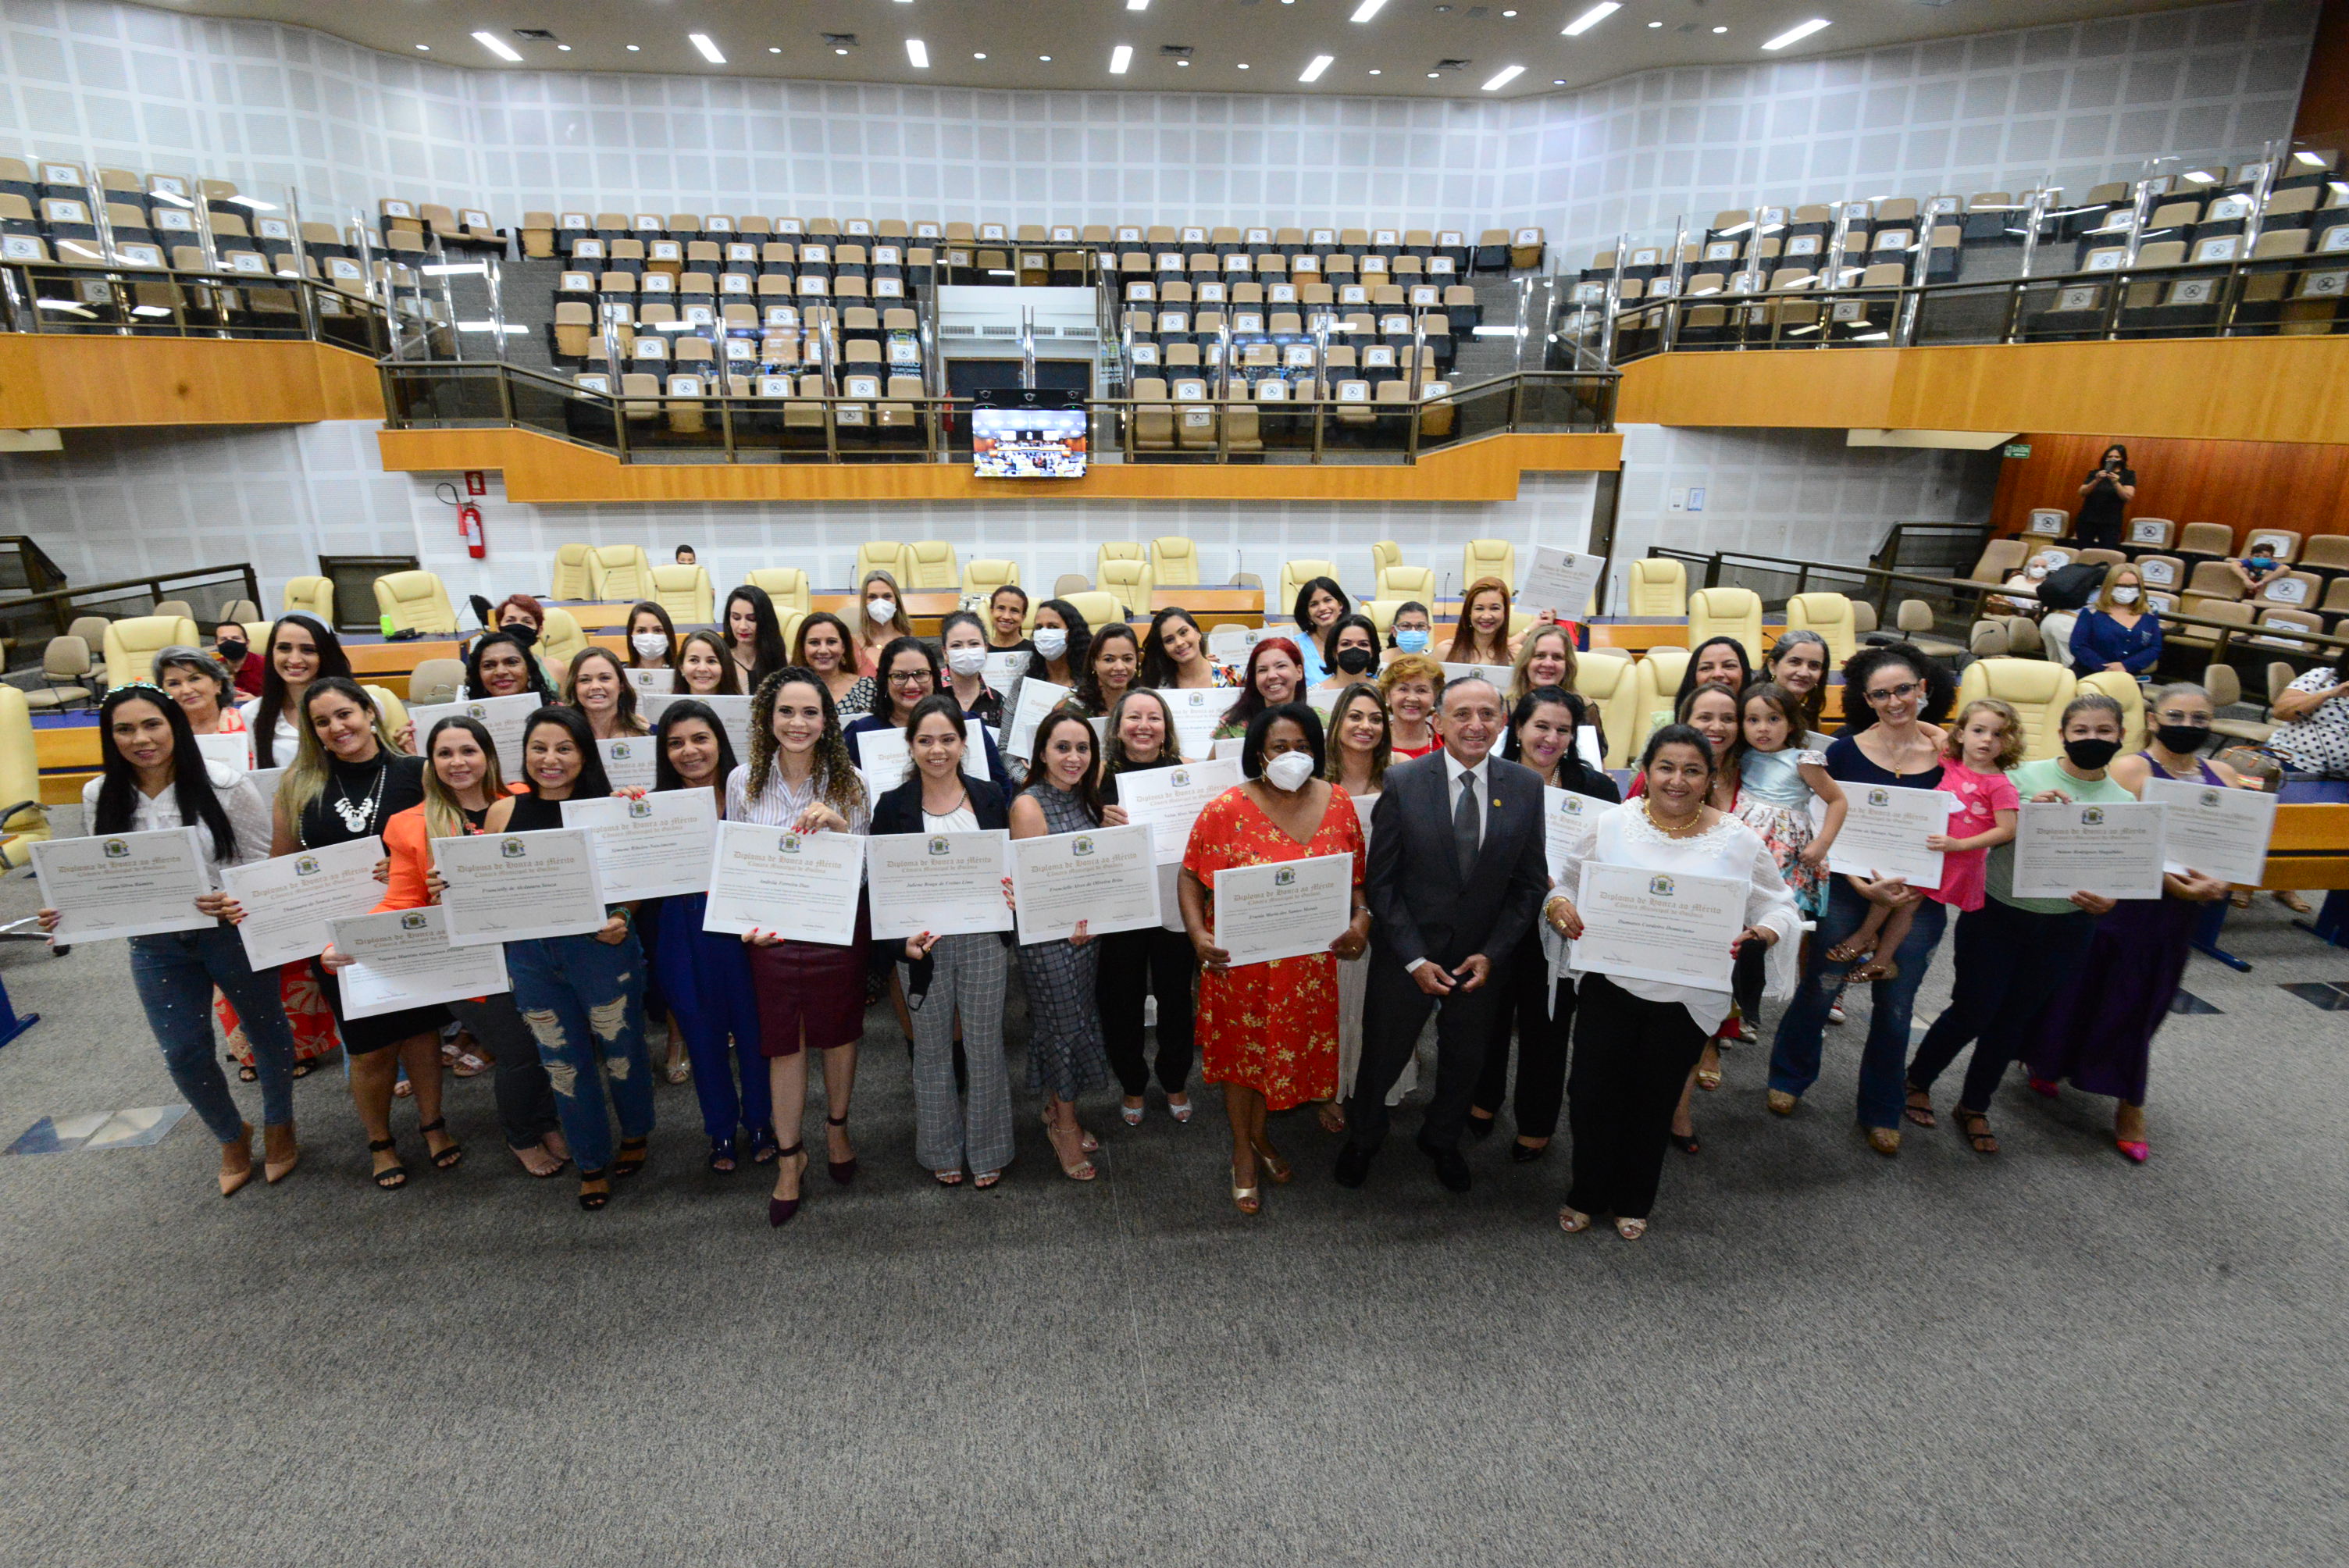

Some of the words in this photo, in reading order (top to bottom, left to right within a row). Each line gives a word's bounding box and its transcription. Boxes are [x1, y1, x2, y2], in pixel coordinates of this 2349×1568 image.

[733, 850, 765, 861] Diploma
[1030, 864, 1062, 872] Diploma
[251, 886, 287, 897] Diploma
[1233, 893, 1264, 901] Diploma
[1599, 891, 1634, 902] Diploma
[1691, 903, 1721, 914] Mérito
[354, 936, 391, 945] Diploma
